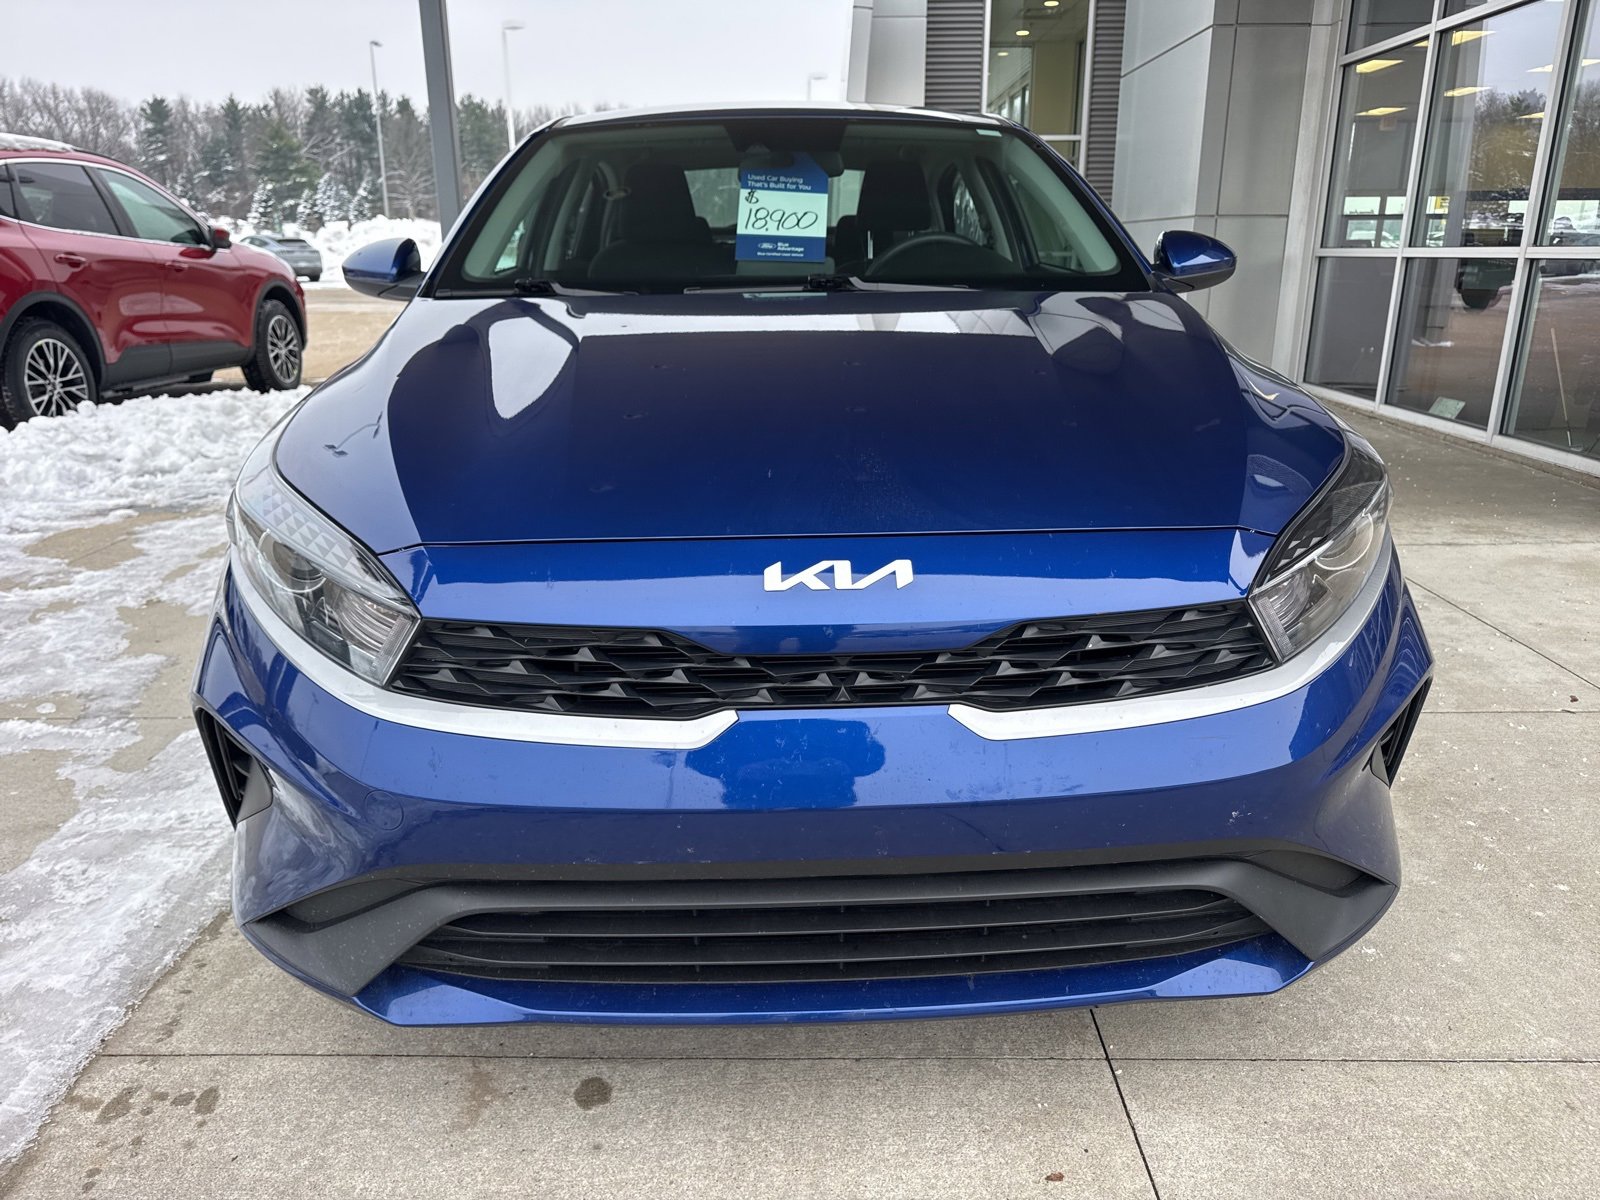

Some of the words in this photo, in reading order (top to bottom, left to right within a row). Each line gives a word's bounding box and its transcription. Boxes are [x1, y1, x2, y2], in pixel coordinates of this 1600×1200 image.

[779, 176, 804, 184] Buying
[744, 189, 760, 204] $
[764, 559, 914, 592] KIA
